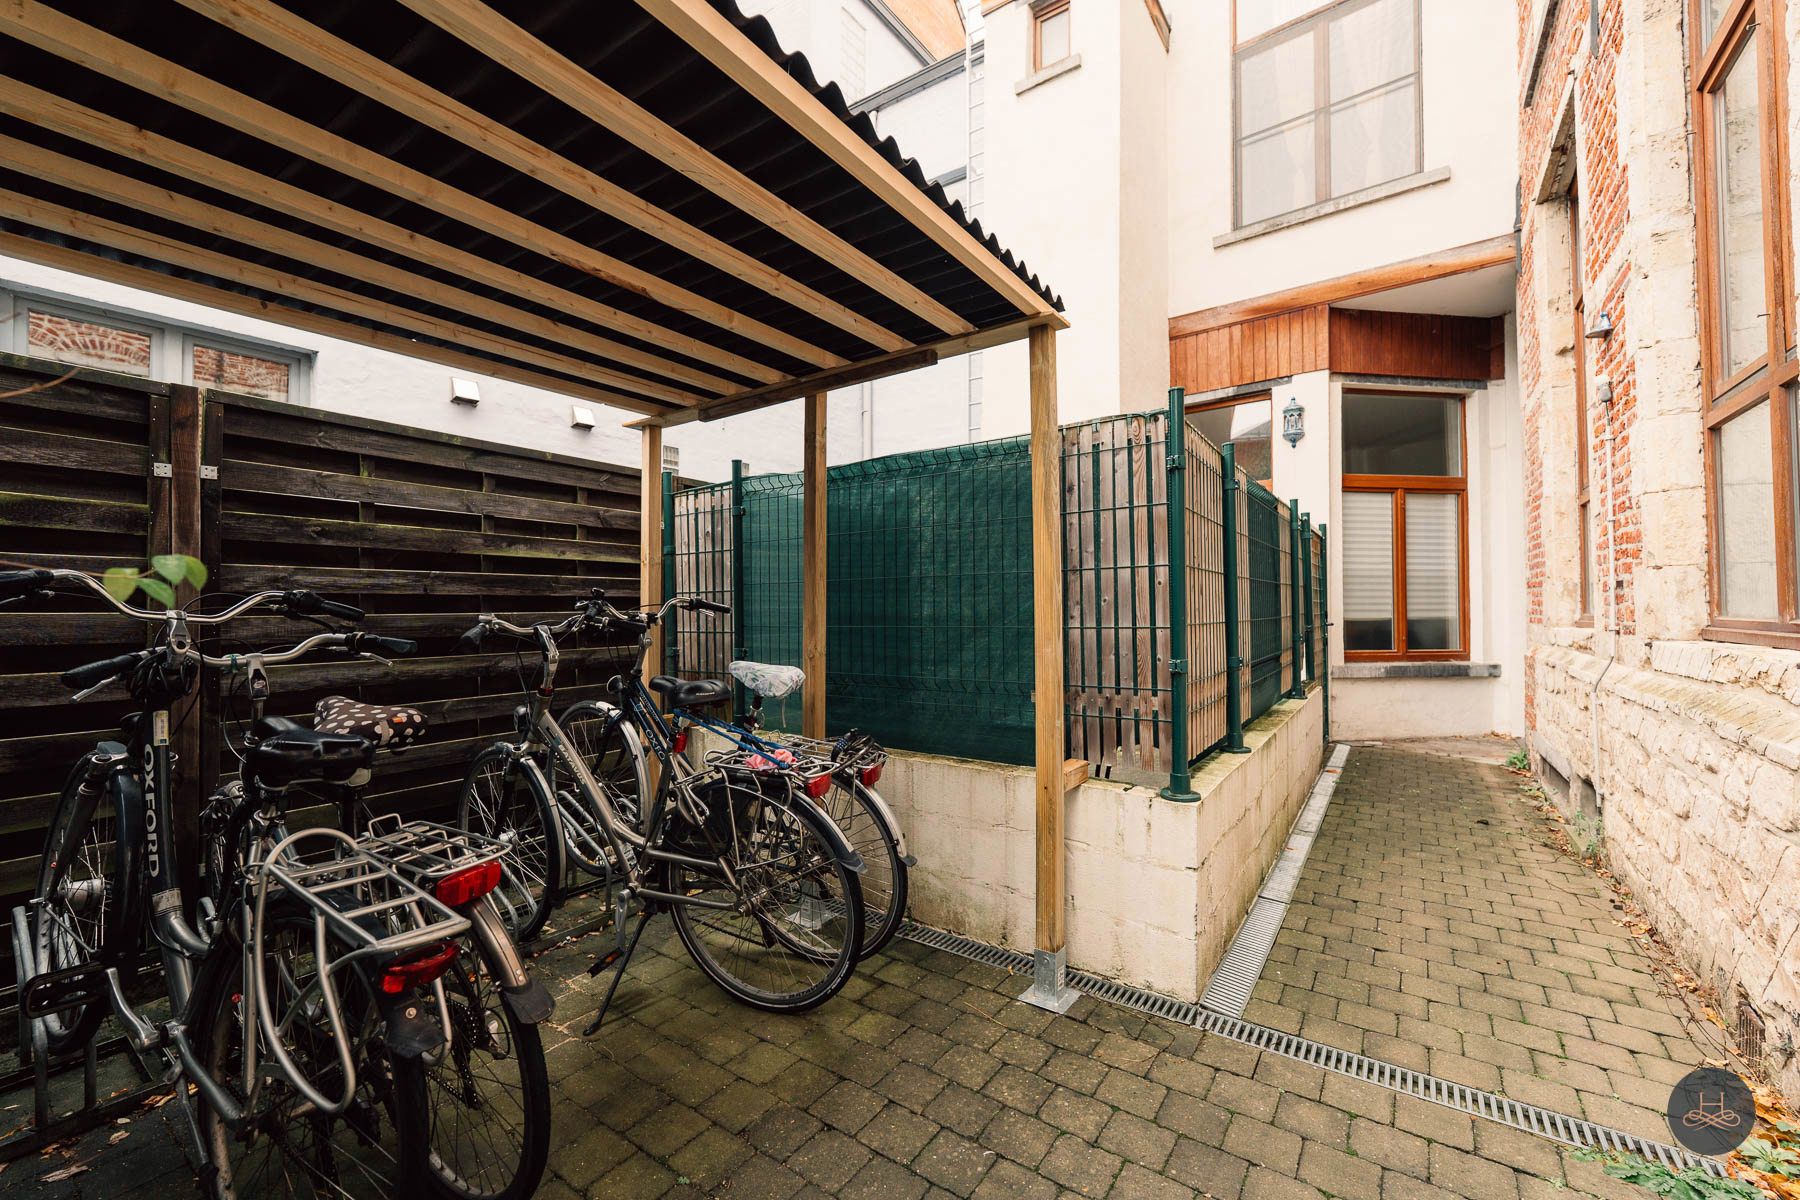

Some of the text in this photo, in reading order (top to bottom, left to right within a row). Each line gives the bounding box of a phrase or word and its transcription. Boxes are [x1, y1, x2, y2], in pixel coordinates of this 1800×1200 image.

[558, 744, 586, 785] BATAVUS
[645, 729, 666, 760] OXFO
[144, 744, 160, 878] OXFORD
